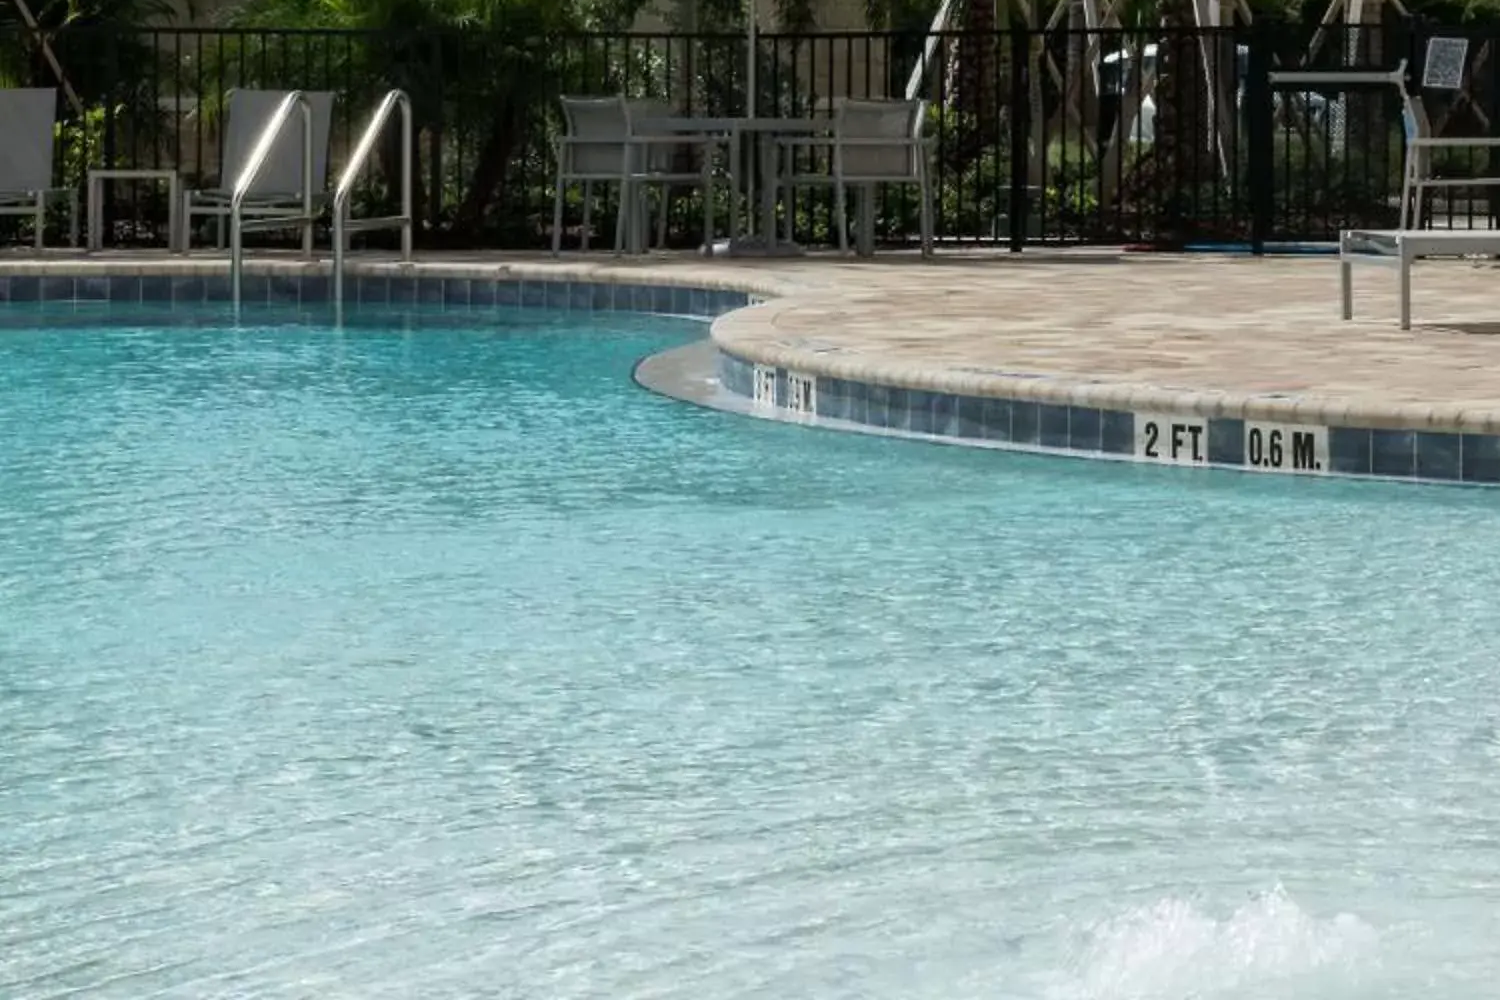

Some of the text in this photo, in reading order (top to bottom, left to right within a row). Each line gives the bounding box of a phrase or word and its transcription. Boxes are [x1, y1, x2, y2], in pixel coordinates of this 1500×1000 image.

[1144, 422, 1204, 461] 2 FT.
[1250, 428, 1322, 470] 0.6 M.
